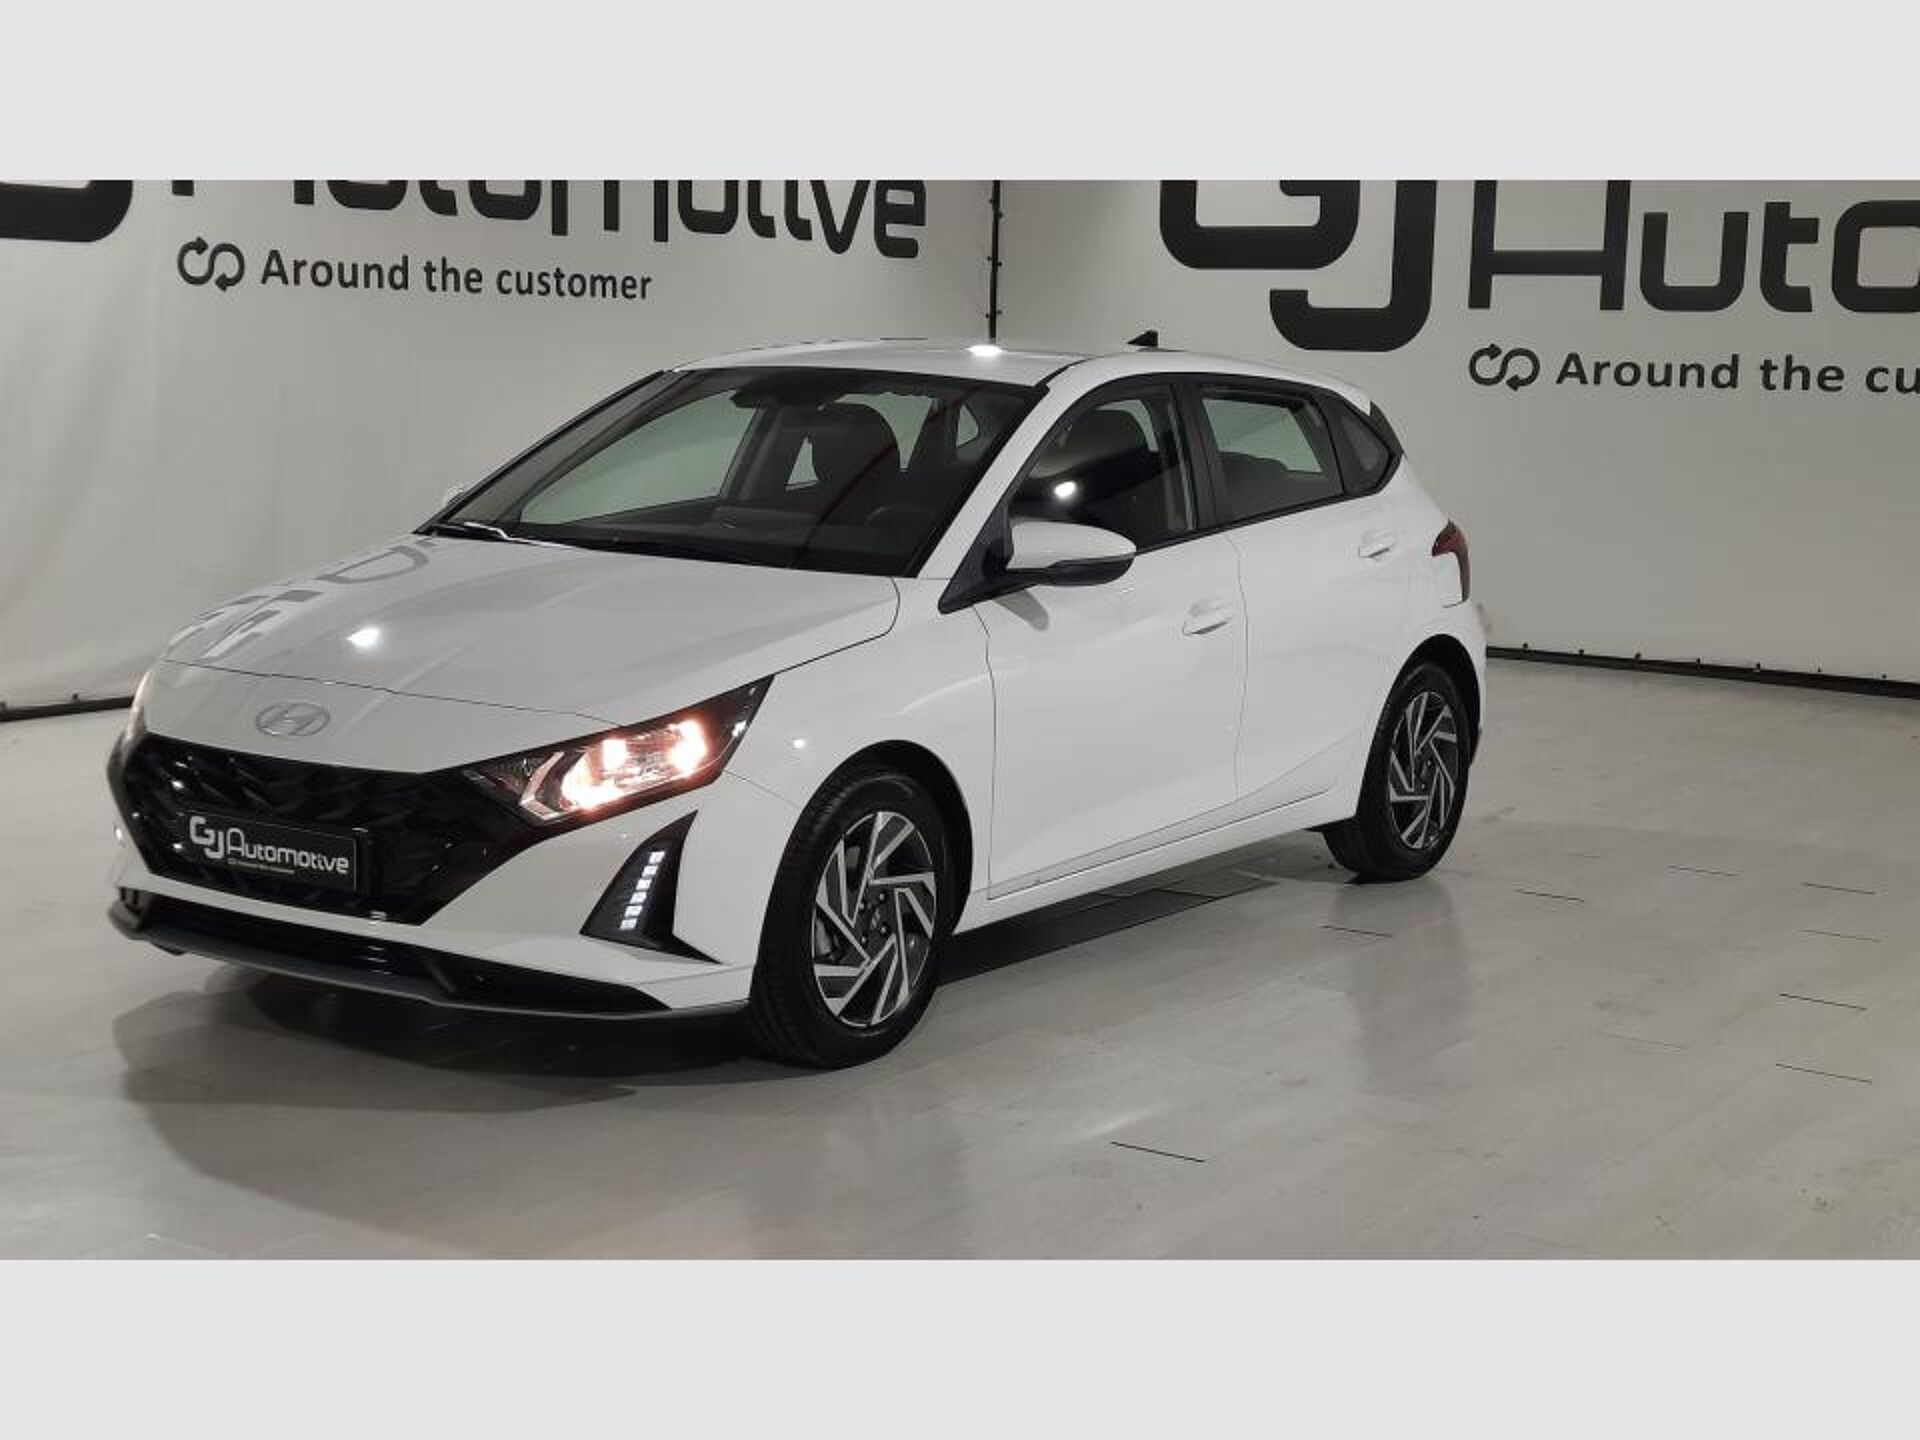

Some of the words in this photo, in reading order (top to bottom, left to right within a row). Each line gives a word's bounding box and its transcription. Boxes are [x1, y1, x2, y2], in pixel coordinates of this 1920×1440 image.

[260, 249, 409, 291] Around
[423, 256, 483, 294] the
[495, 267, 652, 300] customer
[1555, 352, 1740, 390] Around
[1759, 353, 1845, 393] the
[1865, 366, 1920, 395] cu
[189, 815, 225, 860] GJ
[226, 827, 349, 875] Automotive
